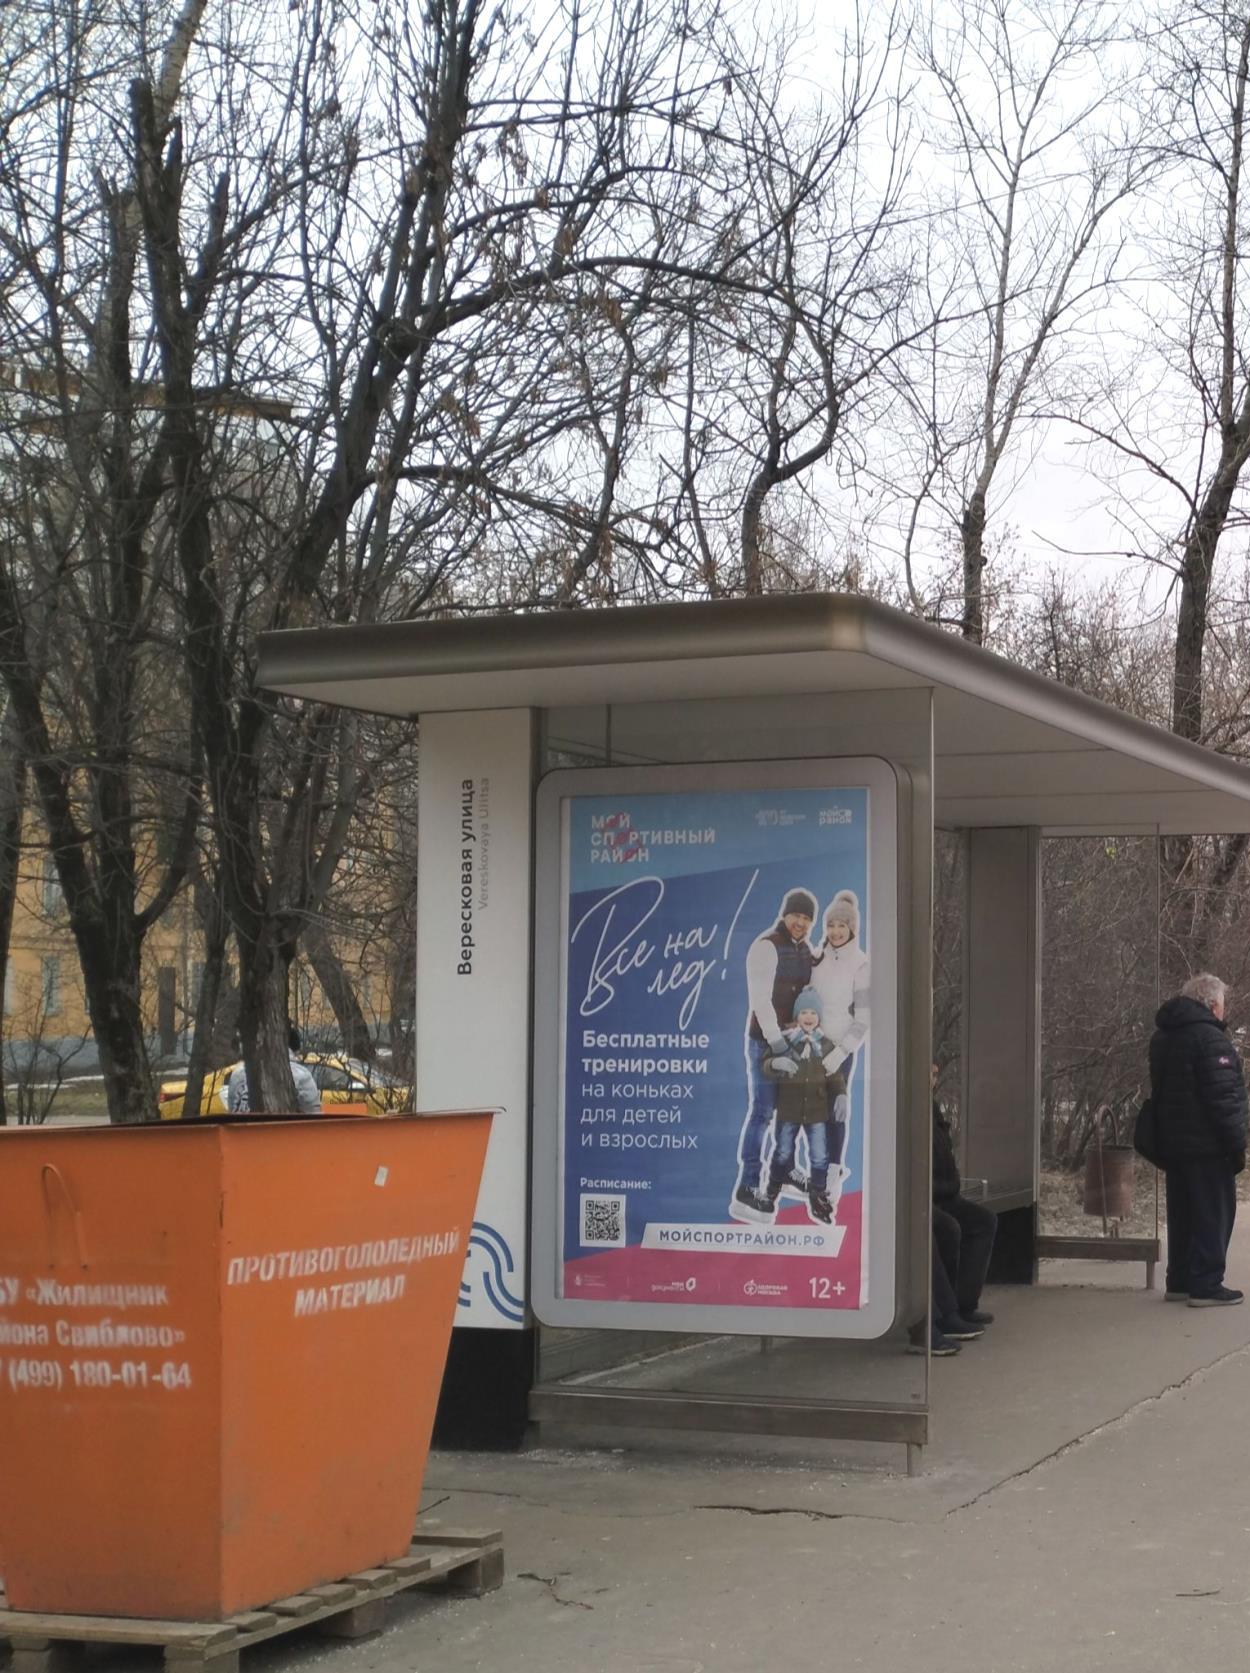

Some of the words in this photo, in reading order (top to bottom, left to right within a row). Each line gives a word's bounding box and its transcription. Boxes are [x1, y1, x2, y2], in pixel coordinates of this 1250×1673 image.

[461, 778, 477, 842] улица
[591, 827, 717, 846] СПРТИВНЫЙ
[477, 823, 492, 911] Vereskovaya
[457, 848, 475, 976] Вересковая
[663, 923, 719, 959] на
[582, 1030, 711, 1049] Бесплатные
[581, 1057, 709, 1076] тренировки
[581, 1083, 605, 1098] на
[611, 1083, 695, 1099] коньках
[580, 1107, 617, 1124] для
[622, 1105, 682, 1125] детей
[581, 1132, 593, 1147] и
[599, 1132, 699, 1151] взрослых
[580, 1176, 652, 1190] Расписание:
[658, 1229, 826, 1248] МОЙСПОРТРАЙОН.РФ
[226, 1227, 461, 1286] ПРОТИВОГОЛОЛЕДНЫЙ
[294, 1274, 406, 1318] МАТЕРИАЛ
[809, 1276, 846, 1298] 12+
[8, 1357, 63, 1393] (499)
[69, 1358, 192, 1390] 180-01-64
